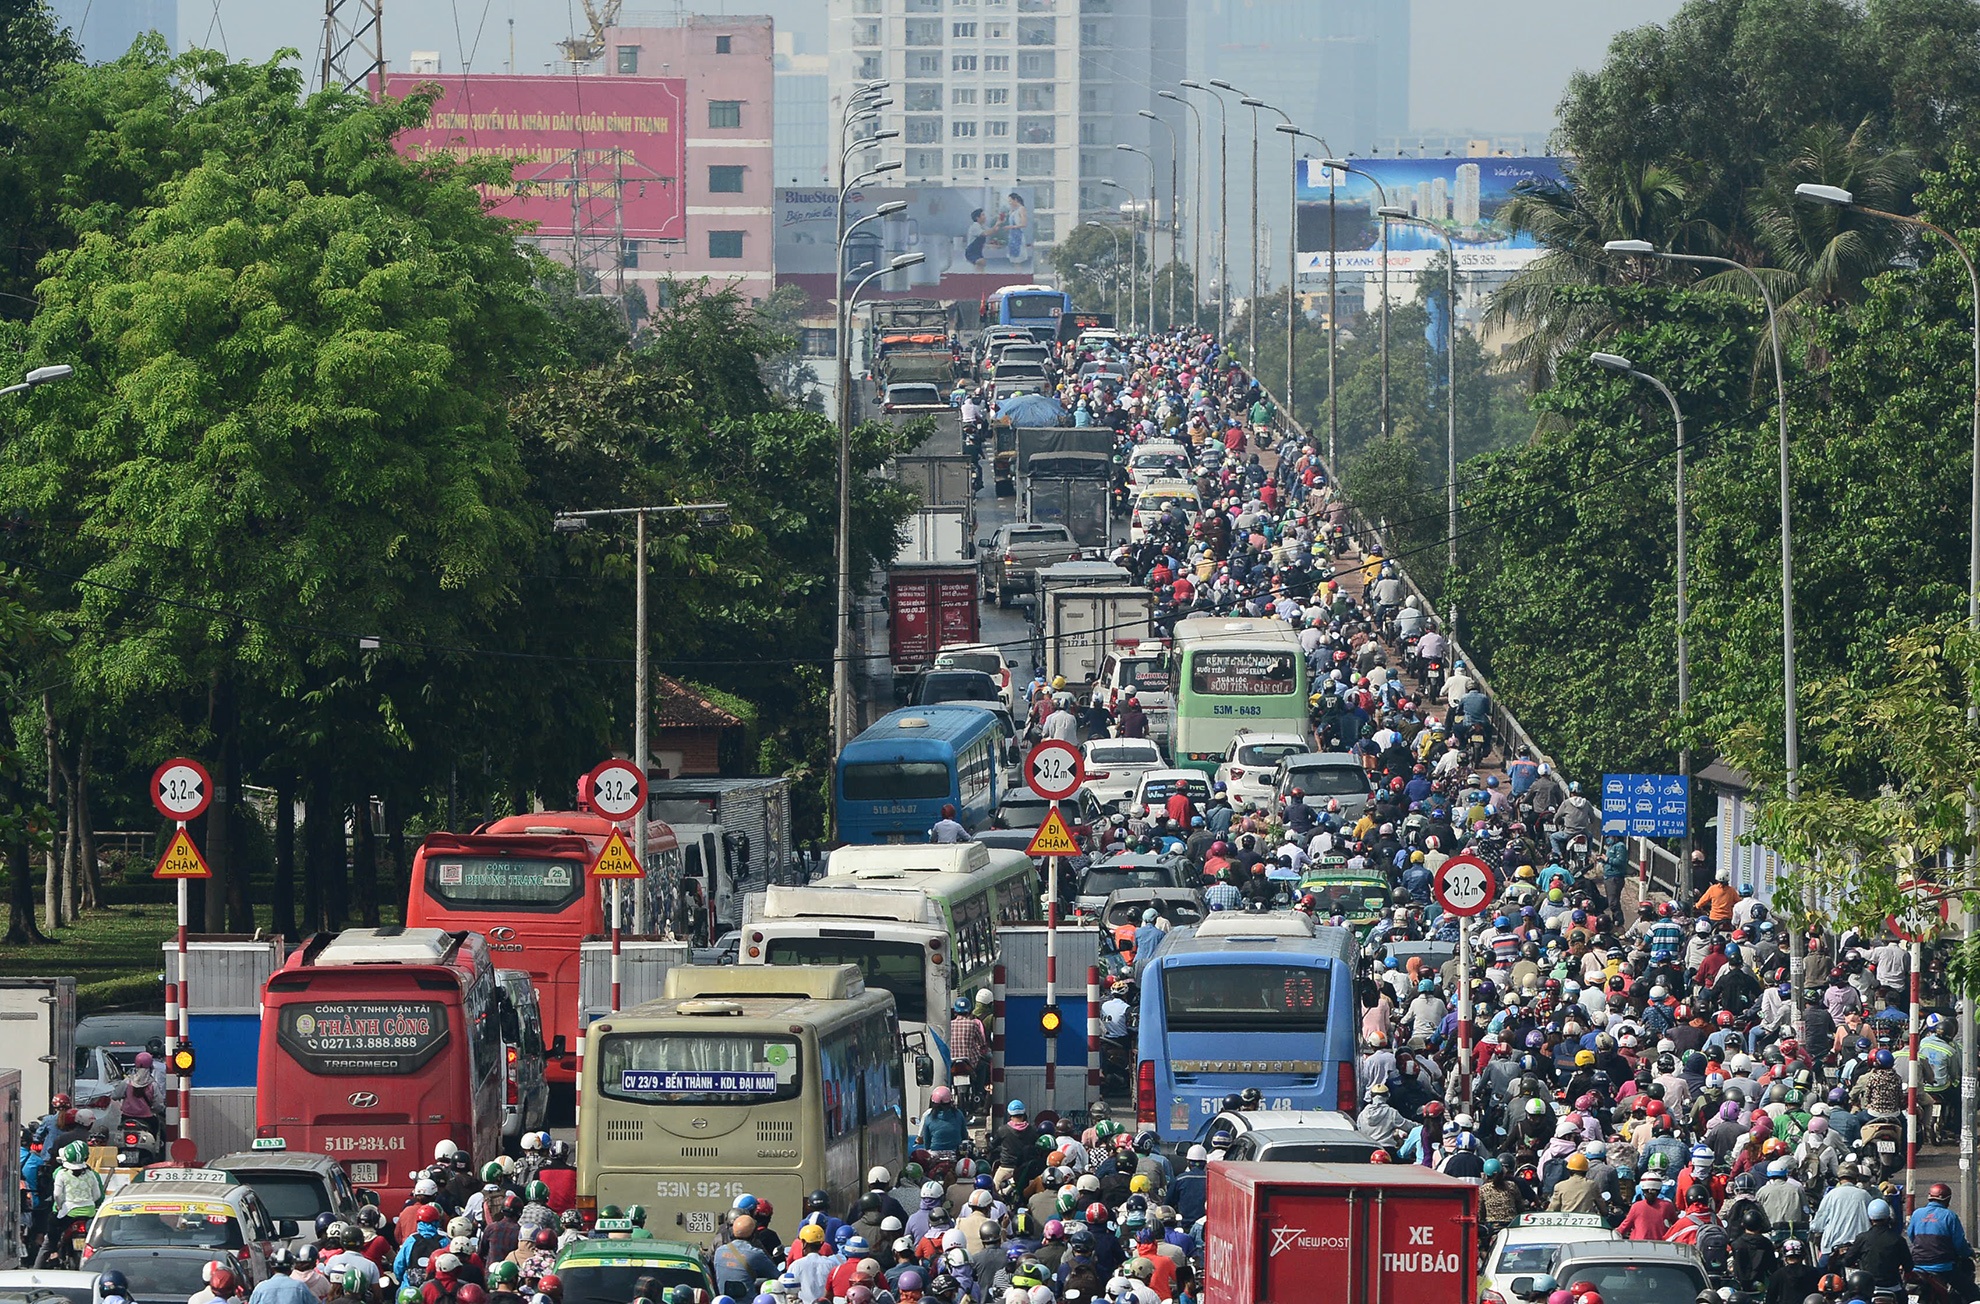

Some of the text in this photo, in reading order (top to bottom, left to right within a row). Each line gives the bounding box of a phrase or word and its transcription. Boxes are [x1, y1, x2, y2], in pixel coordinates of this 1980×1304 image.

[436, 108, 469, 130] CHÍNH
[507, 110, 519, 131] VÀ
[521, 111, 551, 131] NHÂN
[553, 111, 573, 131] DÂN
[576, 112, 604, 135] QUẬN
[607, 112, 632, 133] BÌNH
[634, 116, 669, 137] THẠNH
[1346, 257, 1374, 266] XANH
[1048, 825, 1060, 835] ĐI
[1037, 836, 1069, 850] CHẬM
[176, 846, 188, 856] ĐI
[610, 846, 622, 857] ĐI
[165, 858, 199, 872] CHẬM
[600, 858, 632, 873] CHẬM
[552, 869, 563, 878] 25
[508, 875, 546, 886] TRANG
[315, 1004, 344, 1013] CÔNG
[414, 1004, 430, 1013] TẢI
[317, 1013, 430, 1037] THÀNH CÔNG
[321, 1037, 417, 1050] 0271.3.888.888
[324, 1060, 398, 1068] TRACOMECO
[625, 1076, 636, 1089] CV
[638, 1075, 658, 1089] 23/9
[665, 1072, 683, 1090] BẾN
[684, 1074, 713, 1090] THÀNH
[720, 1077, 737, 1090] KDL
[739, 1078, 755, 1092] ĐẠI
[756, 1078, 775, 1090] NAM
[325, 1136, 406, 1151] 51B-234.61
[757, 1150, 798, 1158] SAMCO
[357, 1163, 373, 1173] 51B
[196, 1173, 209, 1181] 27
[211, 1173, 224, 1181] 27
[691, 1212, 710, 1223] 53N
[1571, 1217, 1584, 1225] 27
[1587, 1217, 1600, 1225] 27
[604, 1220, 626, 1228] TAXI
[689, 1222, 712, 1232] 9216
[1409, 1226, 1434, 1245] XE
[1298, 1237, 1350, 1248] NEWPOST
[1382, 1250, 1460, 1273] THƯ BÁO
